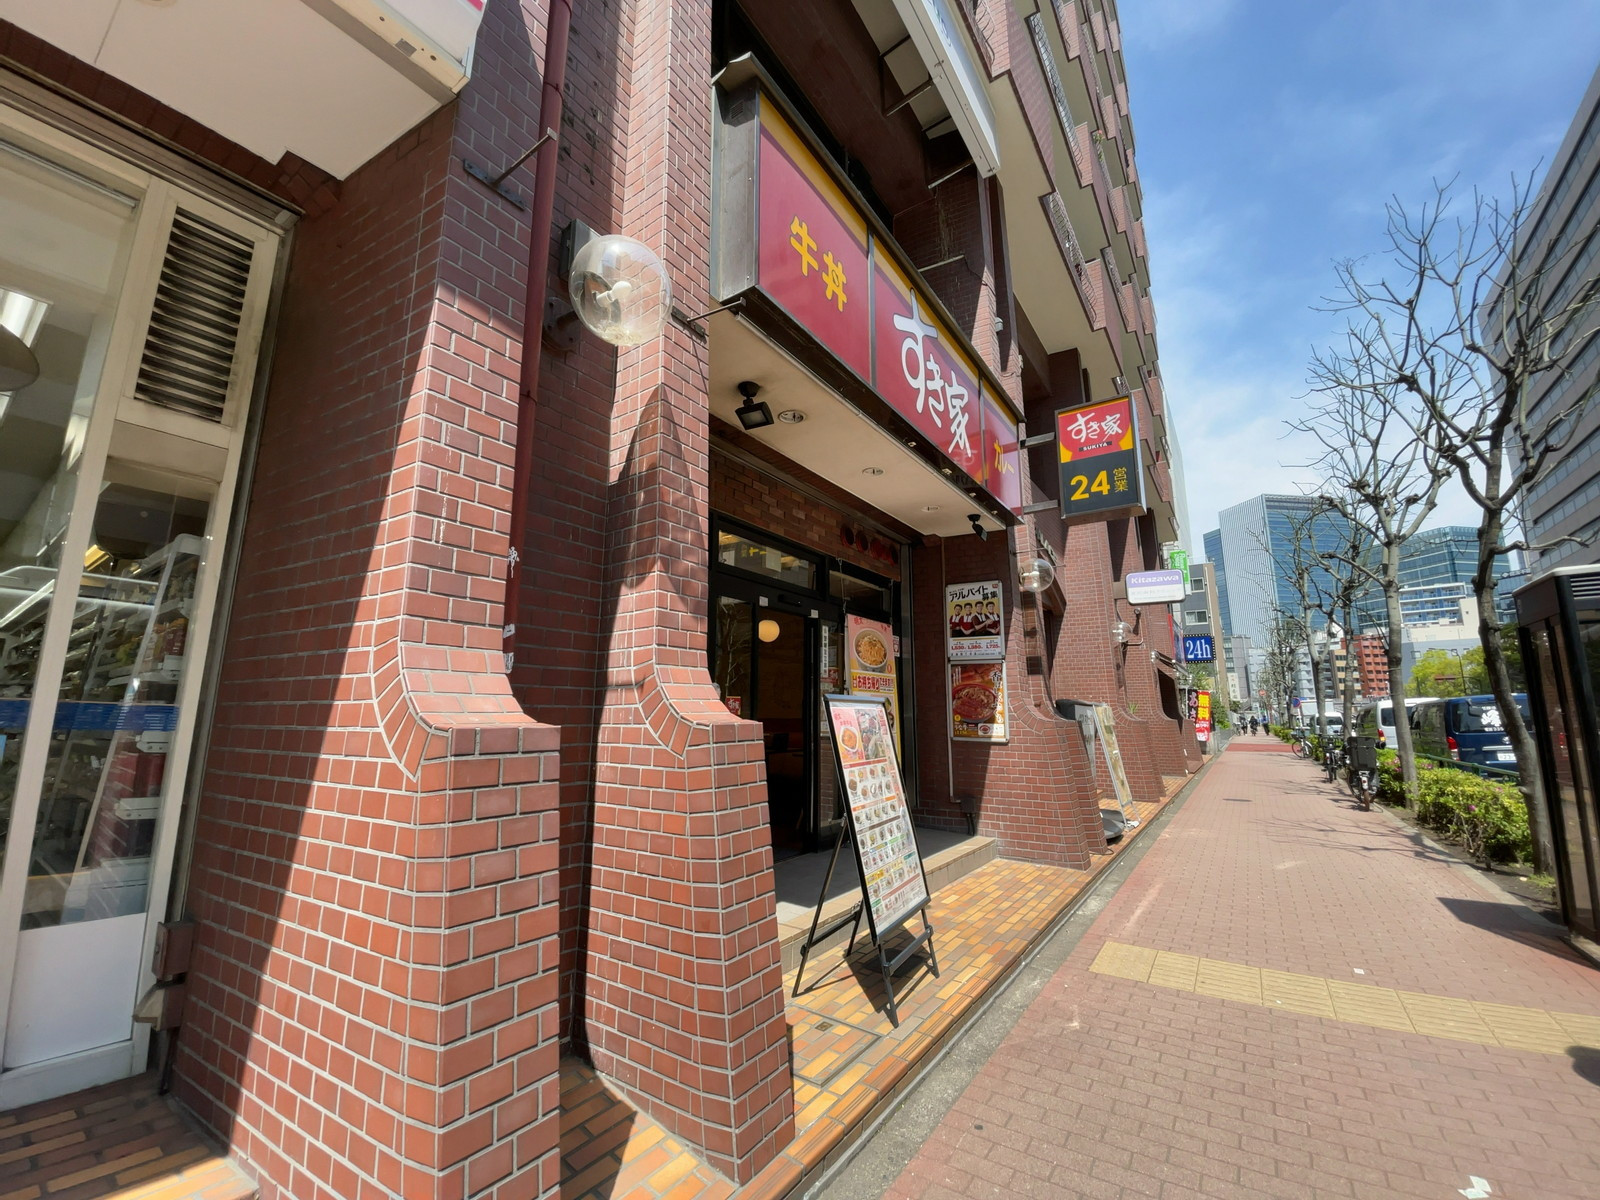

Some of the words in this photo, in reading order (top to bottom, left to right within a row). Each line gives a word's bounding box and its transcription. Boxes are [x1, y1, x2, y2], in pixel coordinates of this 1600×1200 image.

[789, 215, 848, 312] 牛丼
[892, 287, 972, 458] すき家
[993, 439, 1015, 474] カレー
[1067, 412, 1123, 442] すき家
[1082, 442, 1108, 451] SUKIYA
[1070, 470, 1111, 501] 24
[1113, 466, 1128, 493] 営業
[1131, 575, 1179, 585] Kitazawa
[949, 585, 989, 602] アルバイト
[981, 590, 998, 601] 募集
[1185, 638, 1212, 659] 24h
